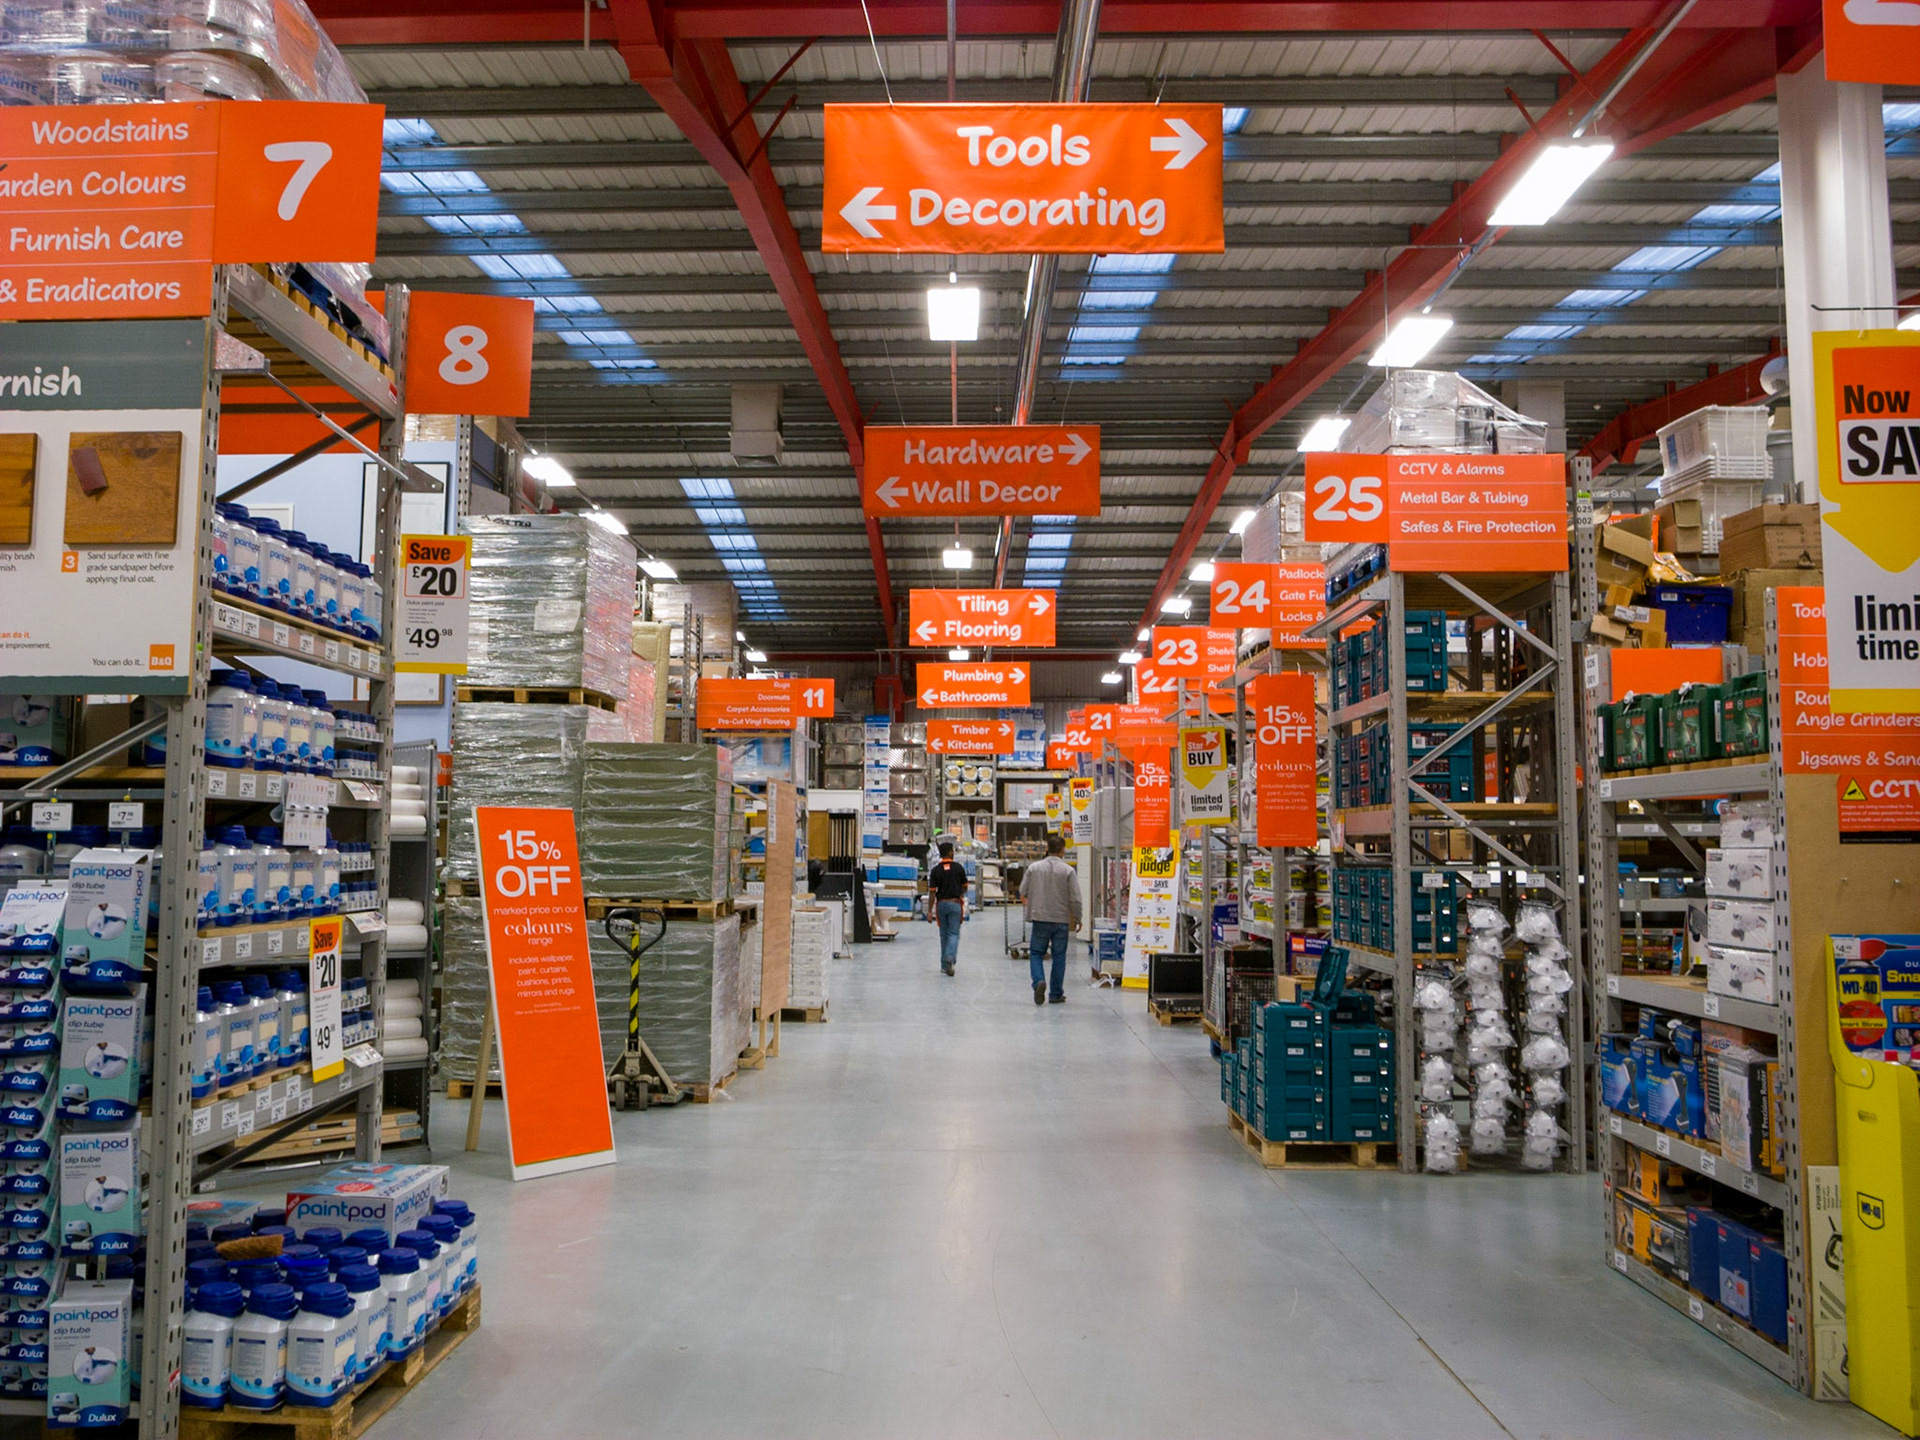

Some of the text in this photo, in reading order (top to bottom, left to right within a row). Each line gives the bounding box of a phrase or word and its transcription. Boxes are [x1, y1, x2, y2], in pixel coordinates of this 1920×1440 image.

[101, 72, 140, 92] WHITE
[32, 118, 189, 145] Woodstains
[957, 124, 1091, 166] Tools
[81, 170, 187, 196] Colours
[264, 141, 333, 221] 7
[908, 187, 1166, 237] Decorating
[9, 225, 184, 252] Furnish Care
[0, 277, 181, 302] & Eradicators
[438, 325, 489, 386] 8
[1843, 384, 1911, 415] Now
[904, 438, 1054, 465] Hardware
[1399, 463, 1505, 476] CCTV & Alarms
[911, 480, 1062, 503] Wall Decor
[1313, 475, 1384, 522] 25
[1400, 491, 1529, 507] Metal Bar & Tubing
[1400, 520, 1556, 533] Safes & Fire Protection
[87, 552, 170, 560] Sand surface with fine
[409, 542, 451, 561] Save
[64, 555, 76, 568] 3
[86, 563, 175, 573] grade sandpaper before
[86, 575, 118, 584] applying
[119, 575, 136, 583] final
[412, 565, 457, 596] £20
[1214, 579, 1270, 614] 24
[1279, 590, 1305, 601] Gate
[957, 595, 1010, 616] Tiling
[217, 610, 227, 622] 02
[1280, 611, 1325, 622] Locks &
[944, 620, 1022, 641] Flooring
[406, 627, 453, 649] £49.98
[1157, 639, 1199, 666] 23
[1856, 634, 1919, 661] time
[92, 658, 107, 666] You
[124, 658, 134, 666] do
[151, 657, 172, 666] B&Q
[1207, 664, 1231, 673] Shelf
[943, 669, 1004, 683] Plumbing
[774, 681, 791, 690] Rugs
[757, 694, 791, 702] Doormats
[802, 688, 825, 709] 11
[939, 691, 1008, 702] Bathrooms
[726, 706, 749, 714] Carpet
[1119, 706, 1159, 715] Tile Gallery
[1263, 705, 1307, 724] 15%
[745, 718, 762, 727] Vinyl
[763, 718, 791, 727] Flooring
[1090, 712, 1112, 731] 21
[1796, 711, 1920, 730] Angle Grinders
[951, 724, 990, 735] Timber
[1258, 725, 1313, 746] OFF
[947, 739, 994, 750] Kitchens
[1187, 741, 1204, 751] Star
[24, 753, 49, 762] Dulux
[1188, 751, 1214, 766] BUY
[1797, 751, 1862, 770] Jigsaws
[1865, 751, 1880, 766] &
[1138, 763, 1166, 775] 15%
[1259, 759, 1313, 772] colours
[1135, 775, 1169, 788] OFF
[1190, 793, 1223, 805] limited
[1191, 803, 1223, 813] time only
[498, 829, 562, 861] 15%
[72, 866, 133, 879] paintpod
[1139, 860, 1171, 874] judge
[71, 882, 85, 890] dip
[495, 864, 571, 898] OFF
[1141, 879, 1169, 888] YOU SAVE
[7, 890, 66, 902] paintpod
[493, 905, 579, 916] marked price on our
[504, 917, 573, 937] colours
[23, 937, 49, 946] Dulux
[313, 928, 334, 950] Save
[528, 937, 553, 946] range
[96, 967, 123, 978] Dulux
[315, 953, 336, 989] £20
[1841, 980, 1878, 995] WD-40
[68, 1005, 133, 1018] paintpod
[96, 1107, 125, 1117] Dulux
[64, 1138, 129, 1152] paintpod
[14, 1179, 41, 1189] Dulux
[394, 1183, 431, 1219] paintpod
[297, 1200, 386, 1222] paintpod
[53, 1307, 119, 1324] paintpod
[88, 1412, 117, 1423] Dulux
